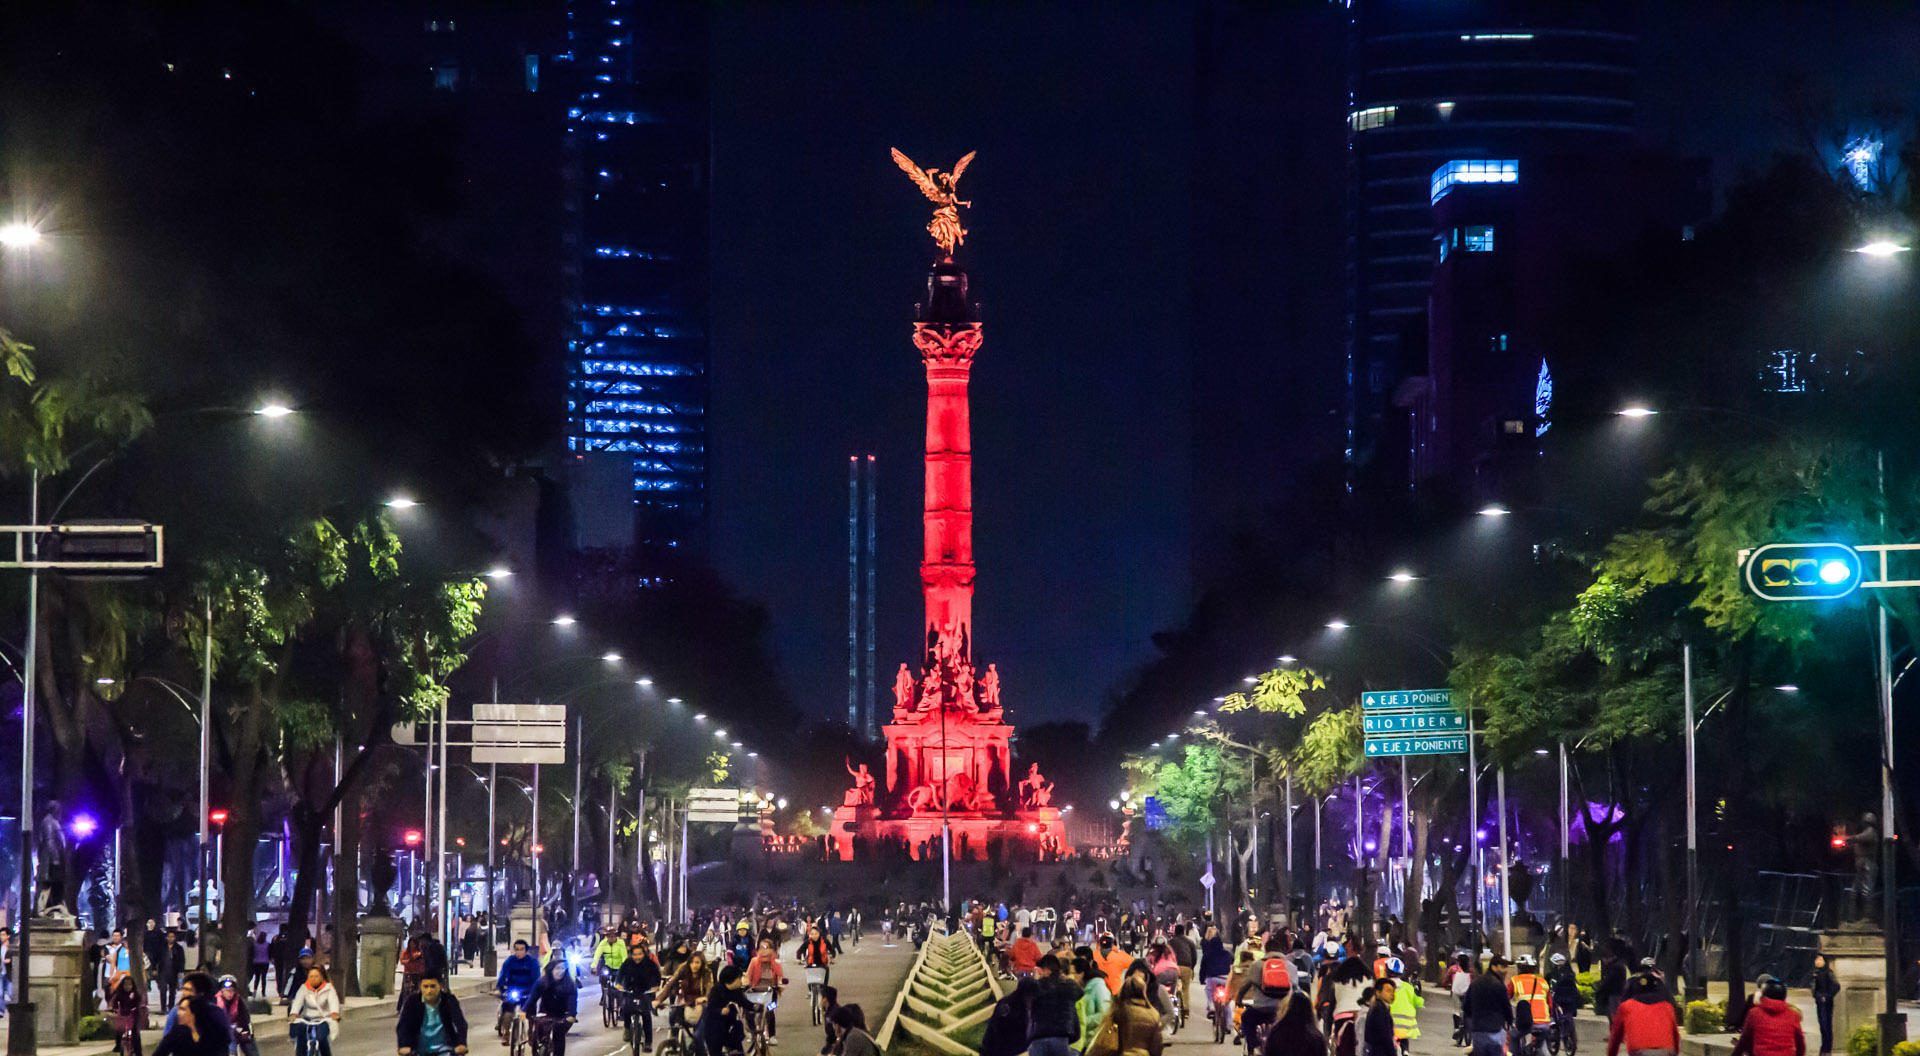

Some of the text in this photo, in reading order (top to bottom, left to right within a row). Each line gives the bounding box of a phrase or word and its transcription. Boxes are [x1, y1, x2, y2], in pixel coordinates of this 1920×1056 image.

[1380, 692, 1453, 705] EJE 3 PONIEN
[1366, 717, 1447, 729] RIO TIBER
[1383, 739, 1464, 753] EJE 2 PONIENTE
